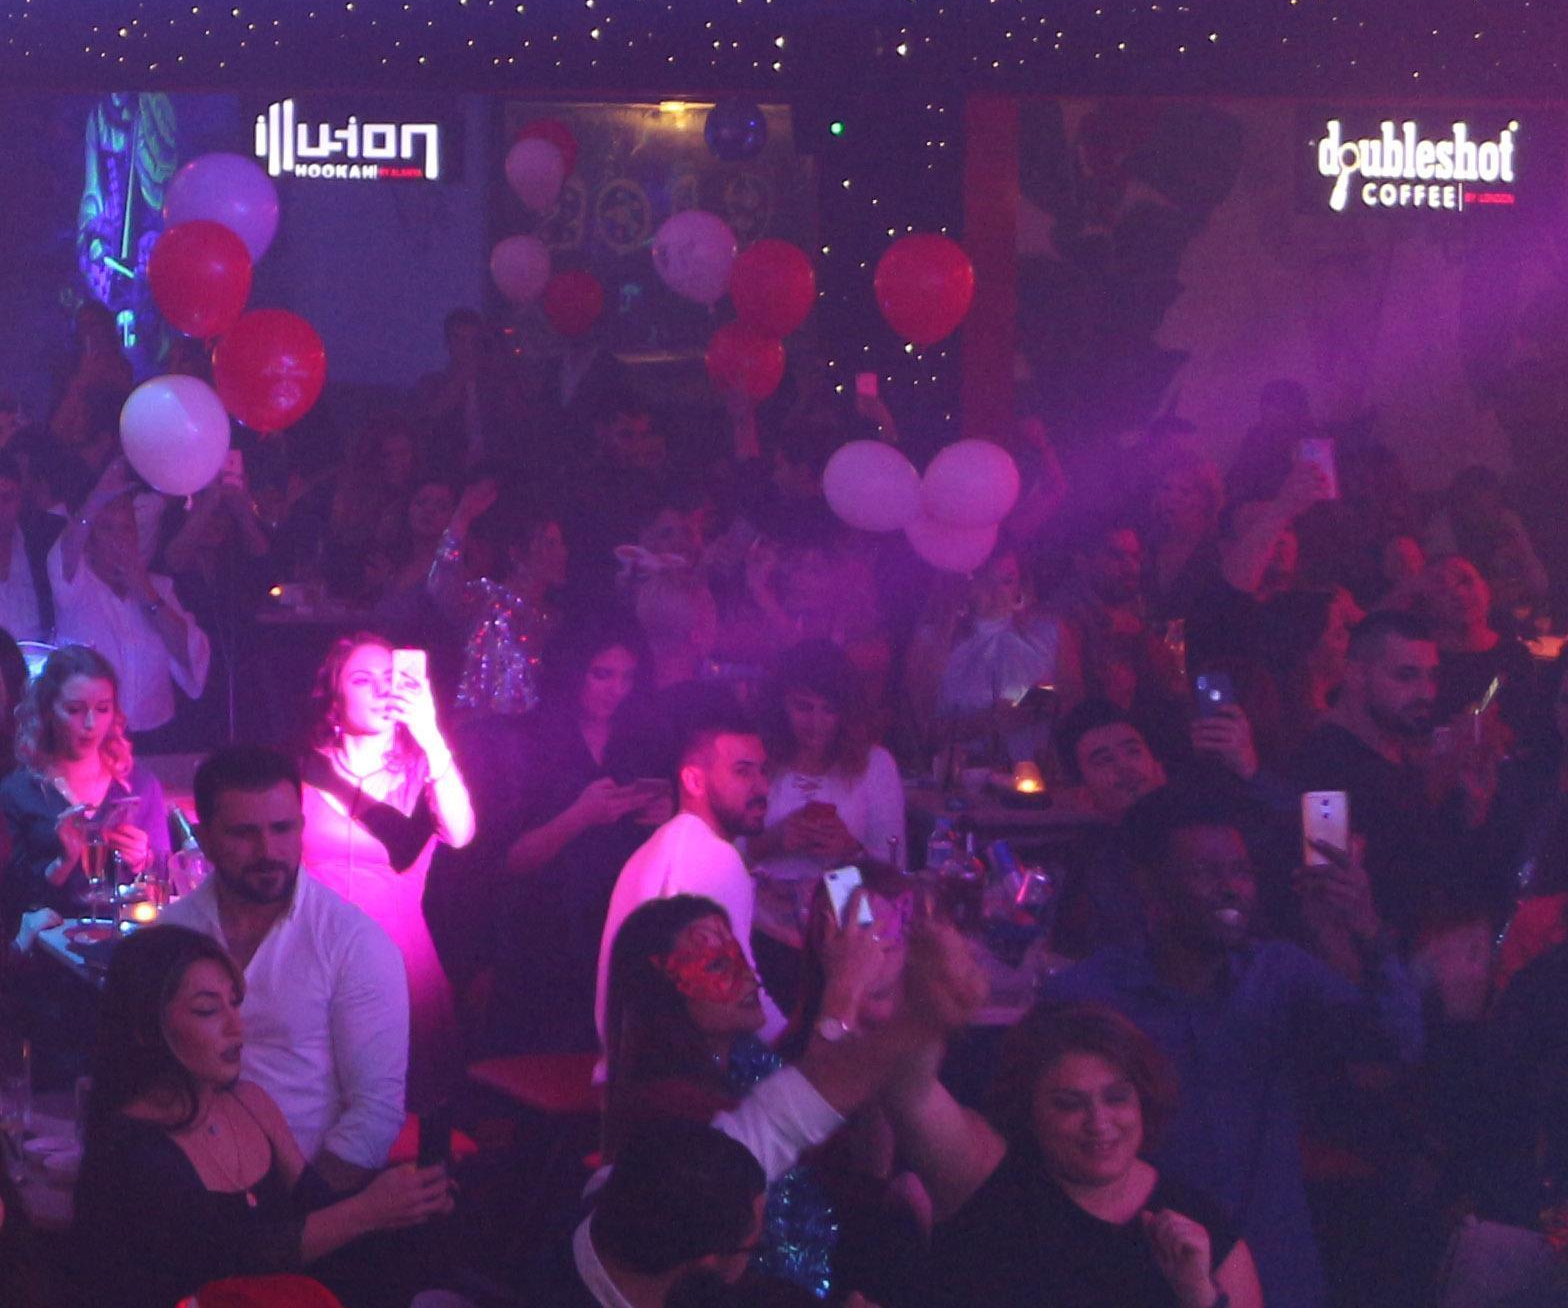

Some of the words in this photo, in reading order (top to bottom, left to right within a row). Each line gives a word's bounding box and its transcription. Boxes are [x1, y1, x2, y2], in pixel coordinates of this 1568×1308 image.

[255, 98, 438, 180] illusion
[1318, 120, 1514, 211] doubleshot
[295, 164, 373, 179] HOOKAH
[1362, 182, 1455, 208] COFFEE
